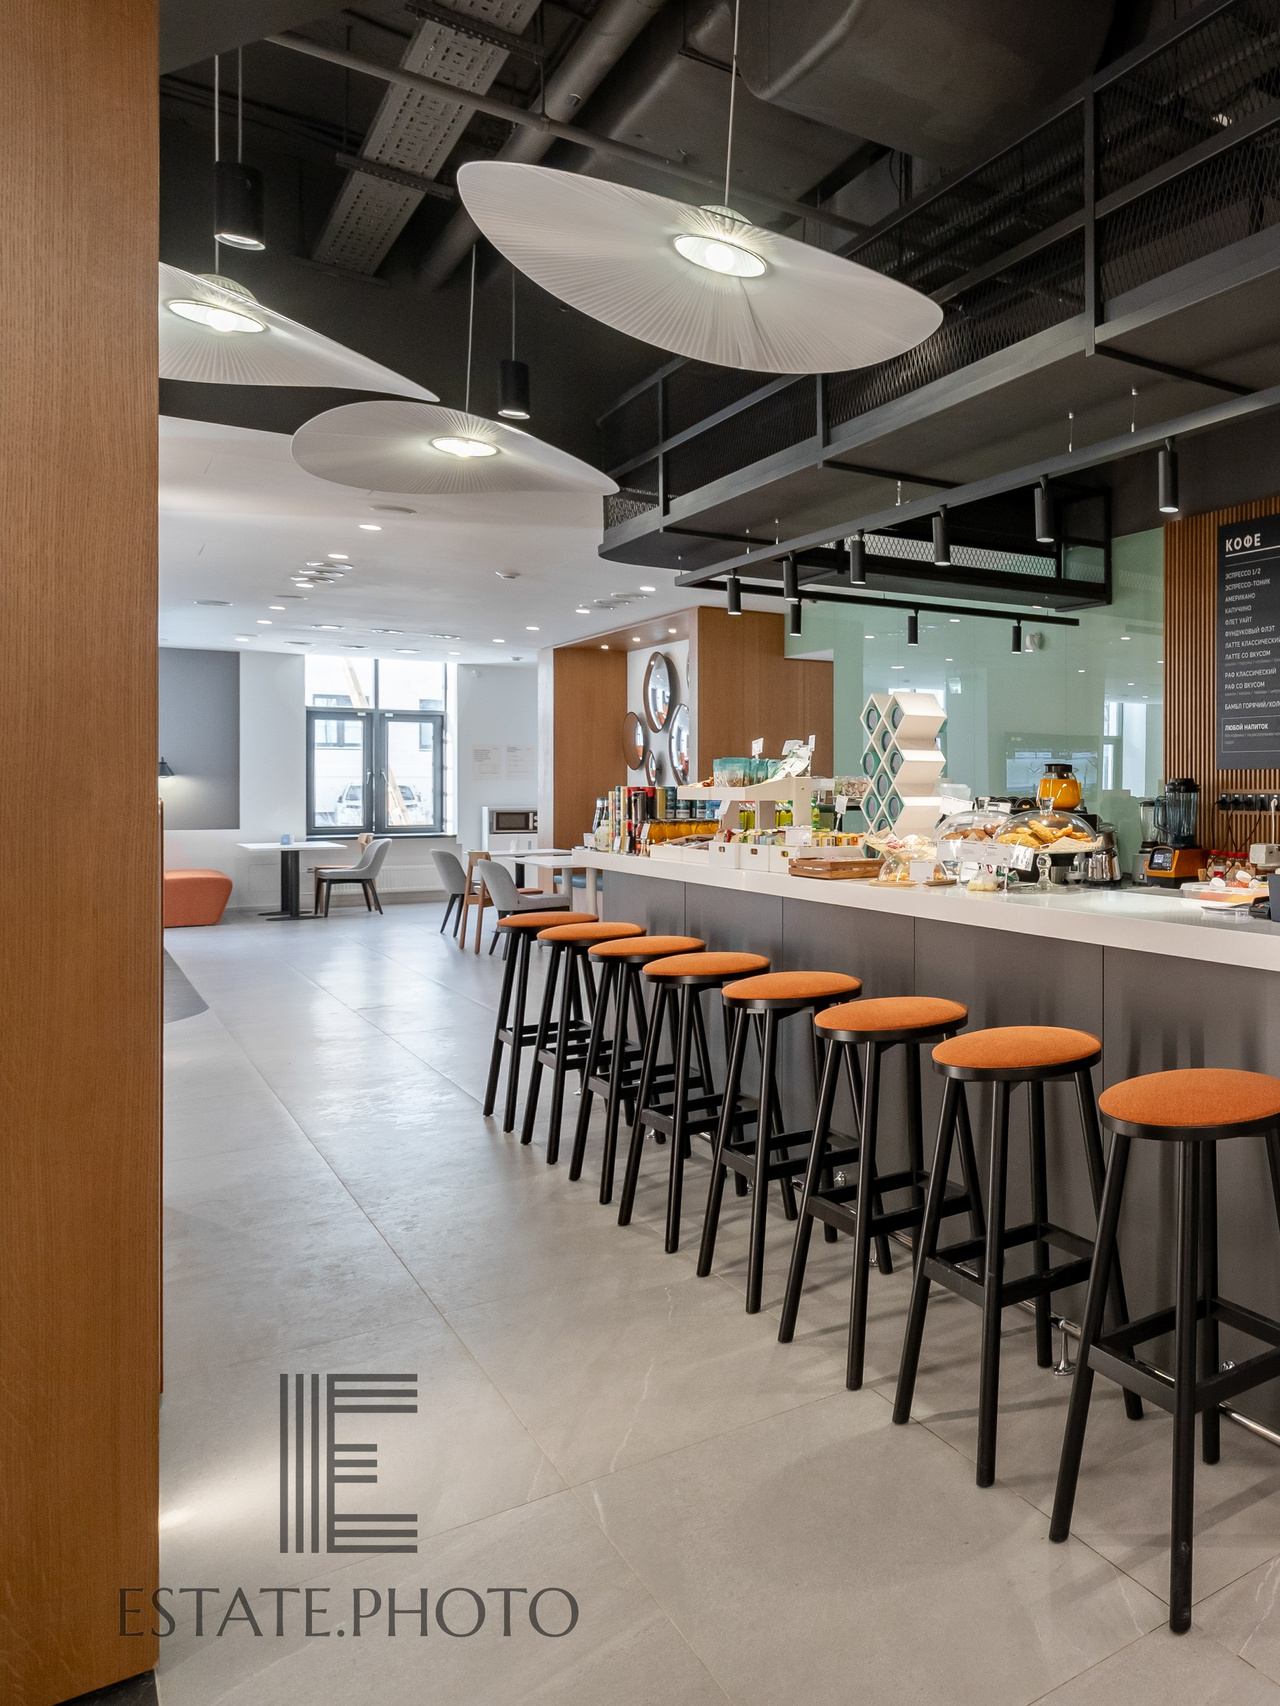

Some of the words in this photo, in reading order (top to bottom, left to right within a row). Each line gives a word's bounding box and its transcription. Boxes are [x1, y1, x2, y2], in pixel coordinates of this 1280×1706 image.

[1225, 533, 1261, 552] КОФЕ
[1225, 570, 1251, 580] ЭСПРЕССО
[1225, 579, 1270, 591] ЭСПРЕССО-ТОНИК
[1225, 593, 1256, 602] АМЕРИКАНО
[1239, 616, 1252, 624] УАЙТ
[1225, 627, 1260, 637] ФУНДУКОВЫЙ
[1250, 650, 1270, 658] ВКУСОМ
[1236, 667, 1276, 677] КЛАССИЧЕСКИЙ
[1225, 723, 1243, 731] ЛЮБОЙ
